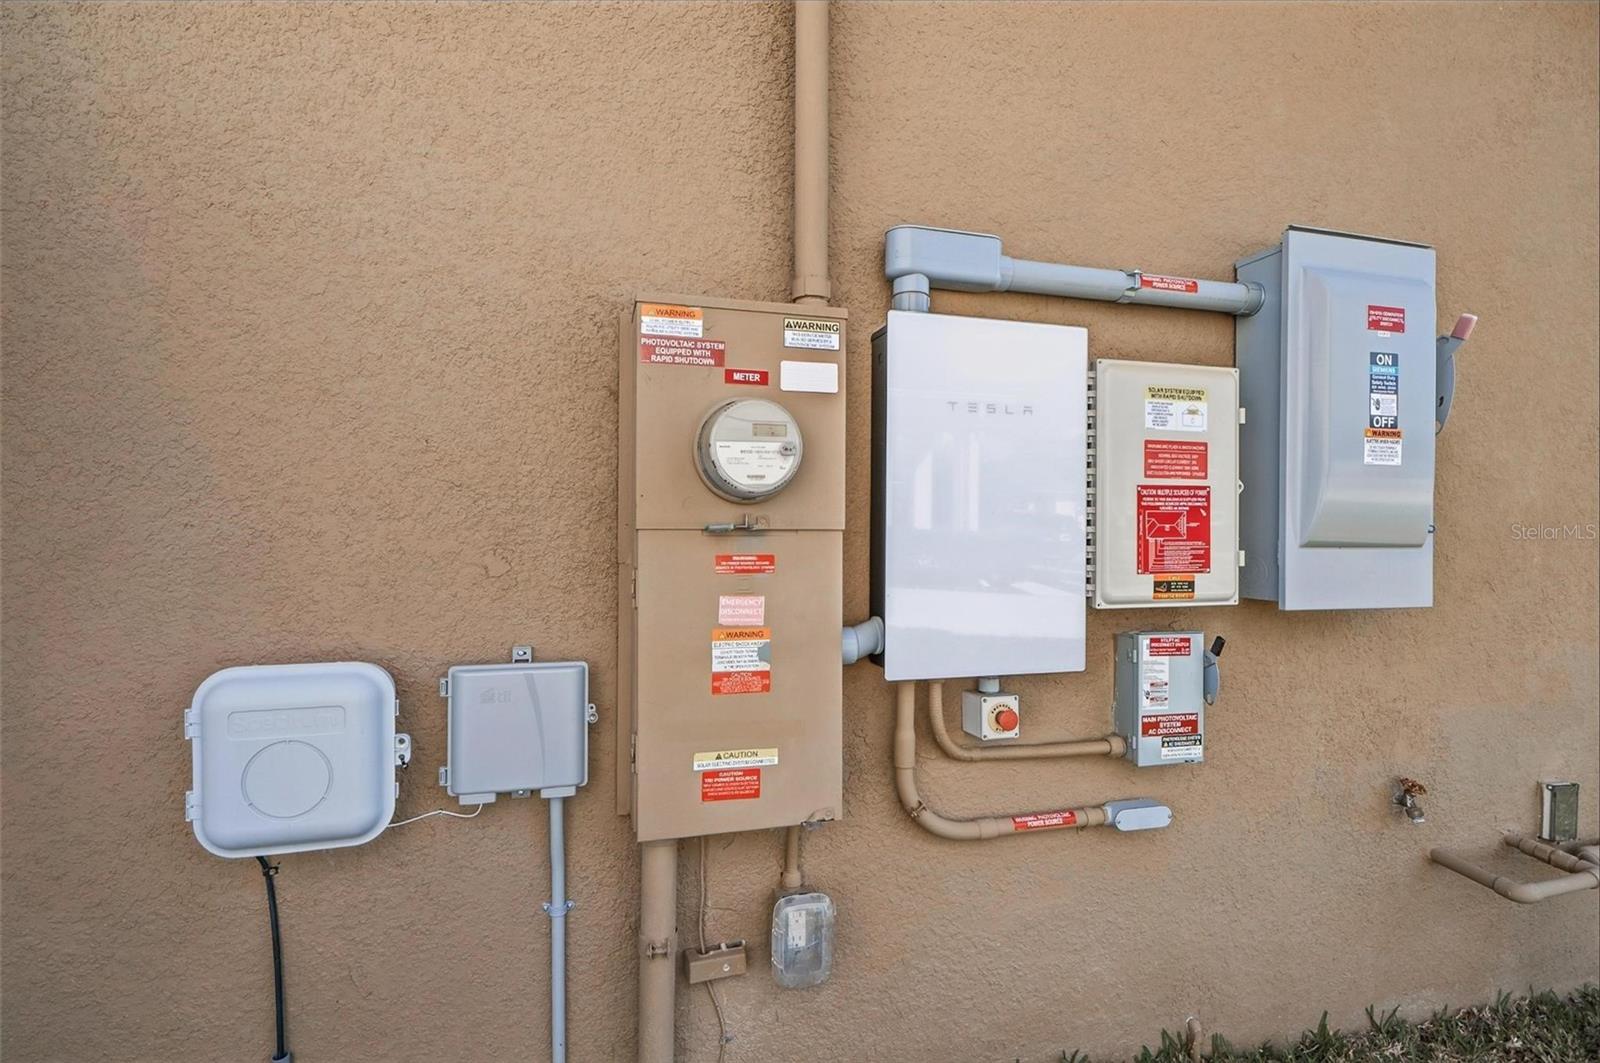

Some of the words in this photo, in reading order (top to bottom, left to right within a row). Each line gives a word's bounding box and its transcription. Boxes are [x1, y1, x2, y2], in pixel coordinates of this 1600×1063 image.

[656, 308, 696, 318] WARNING
[793, 320, 839, 332] WARNING
[641, 338, 695, 349] PHOTOVOLTAIC
[696, 342, 725, 351] SYSTEM
[656, 347, 692, 356] EQUIPPED
[650, 354, 673, 364] RAPID
[674, 356, 715, 366] SHUTDOWN
[1376, 354, 1392, 366] ON
[733, 372, 761, 382] METER
[946, 401, 1033, 416] TESLA
[1373, 416, 1395, 428] OFF
[1372, 430, 1401, 438] WARNING
[721, 598, 762, 606] EMERGENCY
[720, 608, 762, 616] DISCONNECT
[726, 630, 764, 638] WARNING
[1157, 714, 1198, 722] PHOTOVOLTAIC
[1157, 726, 1192, 734] DISCONNECT
[723, 750, 758, 760] CAUTION
